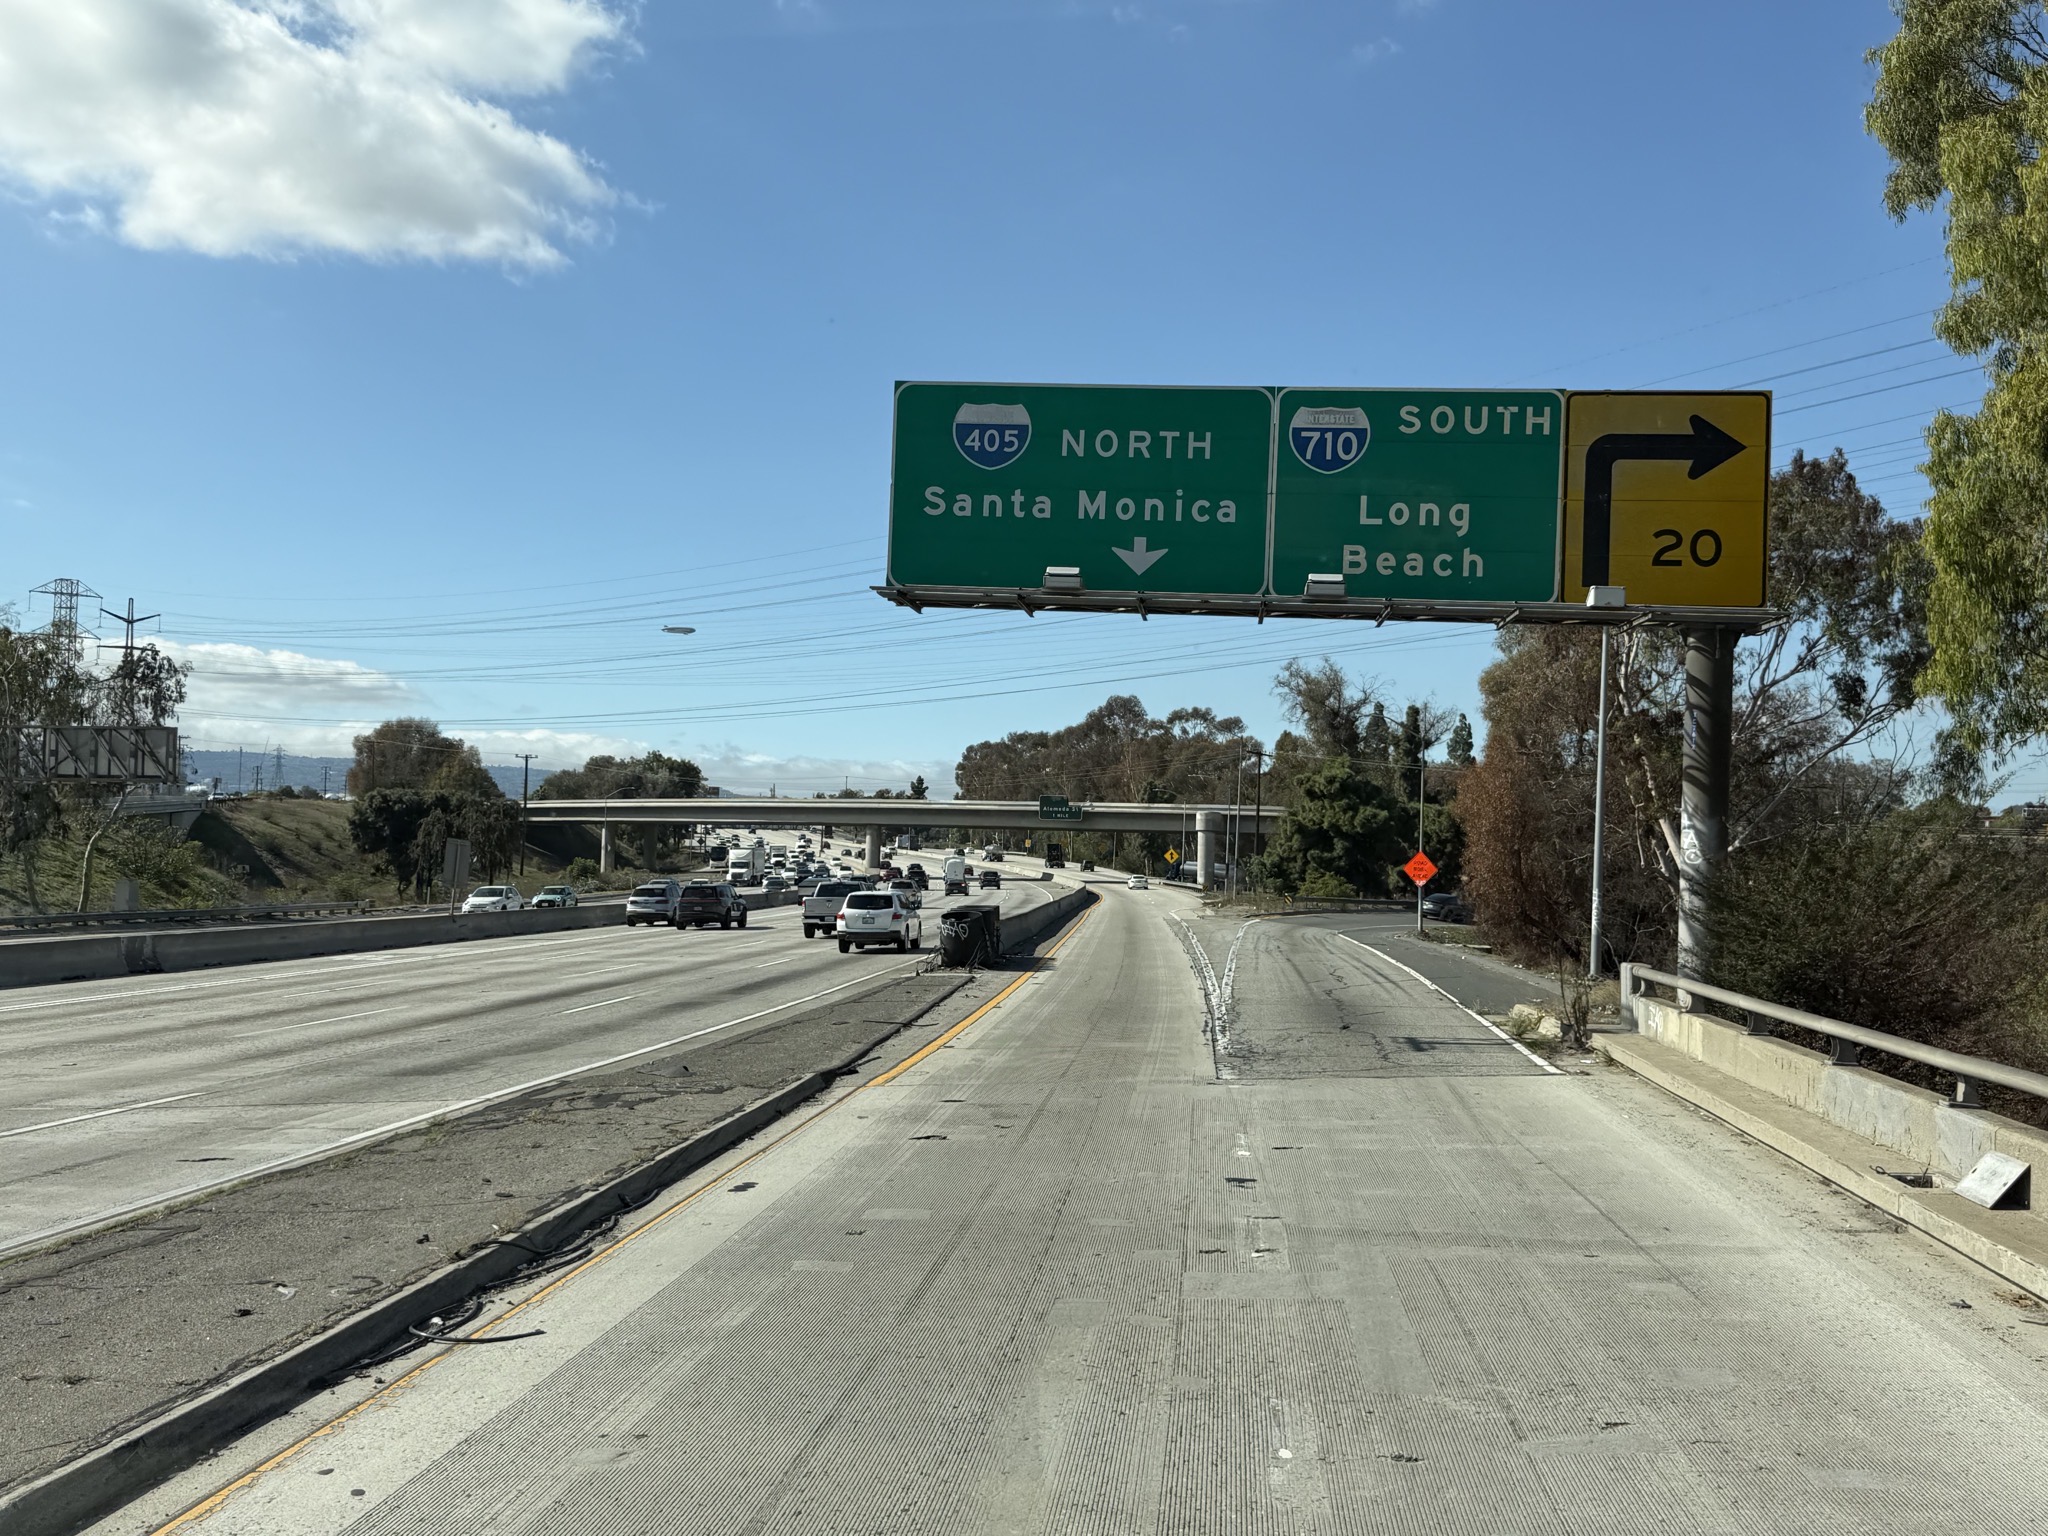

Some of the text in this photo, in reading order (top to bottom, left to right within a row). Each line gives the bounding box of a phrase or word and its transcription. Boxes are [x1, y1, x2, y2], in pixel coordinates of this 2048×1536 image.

[1398, 405, 1551, 435] SOUTH
[964, 429, 1019, 453] 405
[1061, 429, 1212, 460] NORTH
[1300, 431, 1358, 461] 710
[923, 486, 1237, 523] Santa Monica
[1359, 495, 1470, 538] Long
[1342, 544, 1484, 577] Beach
[1651, 528, 1723, 568] 20
